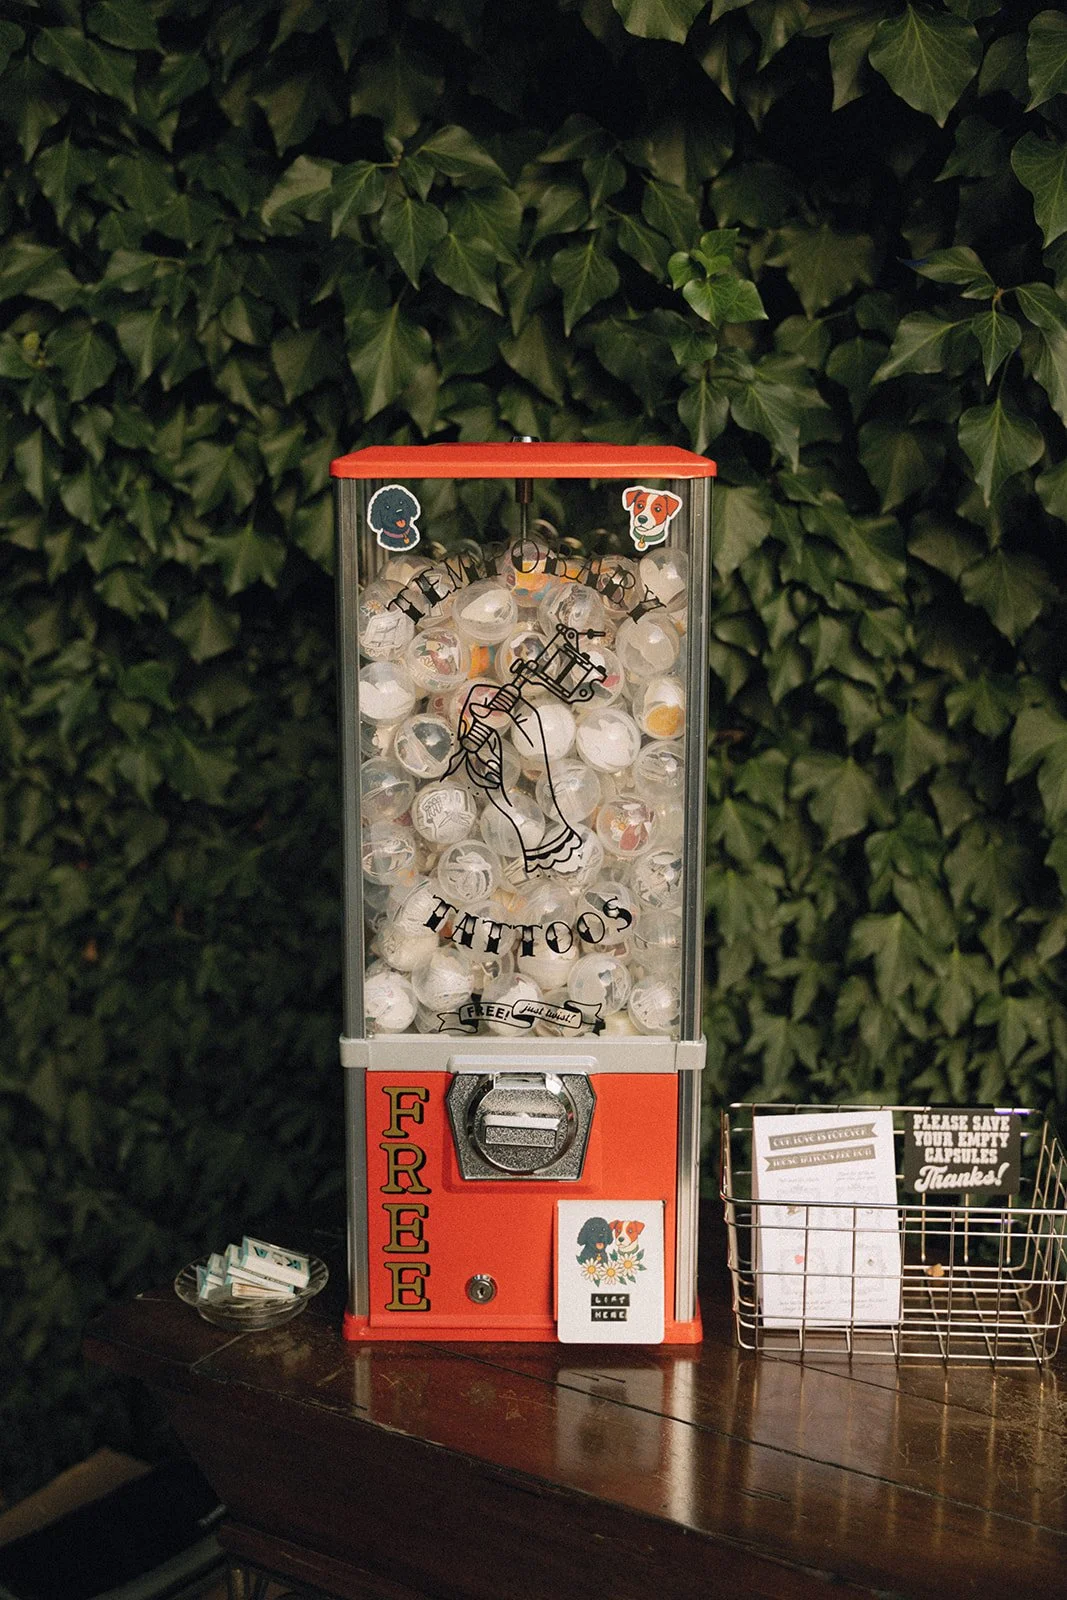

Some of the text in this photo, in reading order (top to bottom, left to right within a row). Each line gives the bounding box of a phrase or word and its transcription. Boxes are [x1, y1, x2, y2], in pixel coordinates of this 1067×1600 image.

[386, 538, 667, 624] TEMPORARY
[422, 895, 633, 957] TATTOOS
[467, 1003, 577, 1023] FREE! just twist!
[913, 1114, 1010, 1131] PLEASE SAVE
[913, 1131, 1010, 1148] YOUR EMPTY
[925, 1147, 998, 1164] CAPSULES
[914, 1162, 1010, 1192] Thanks!
[379, 1086, 431, 1312] FREE
[595, 1295, 626, 1304] LIFT
